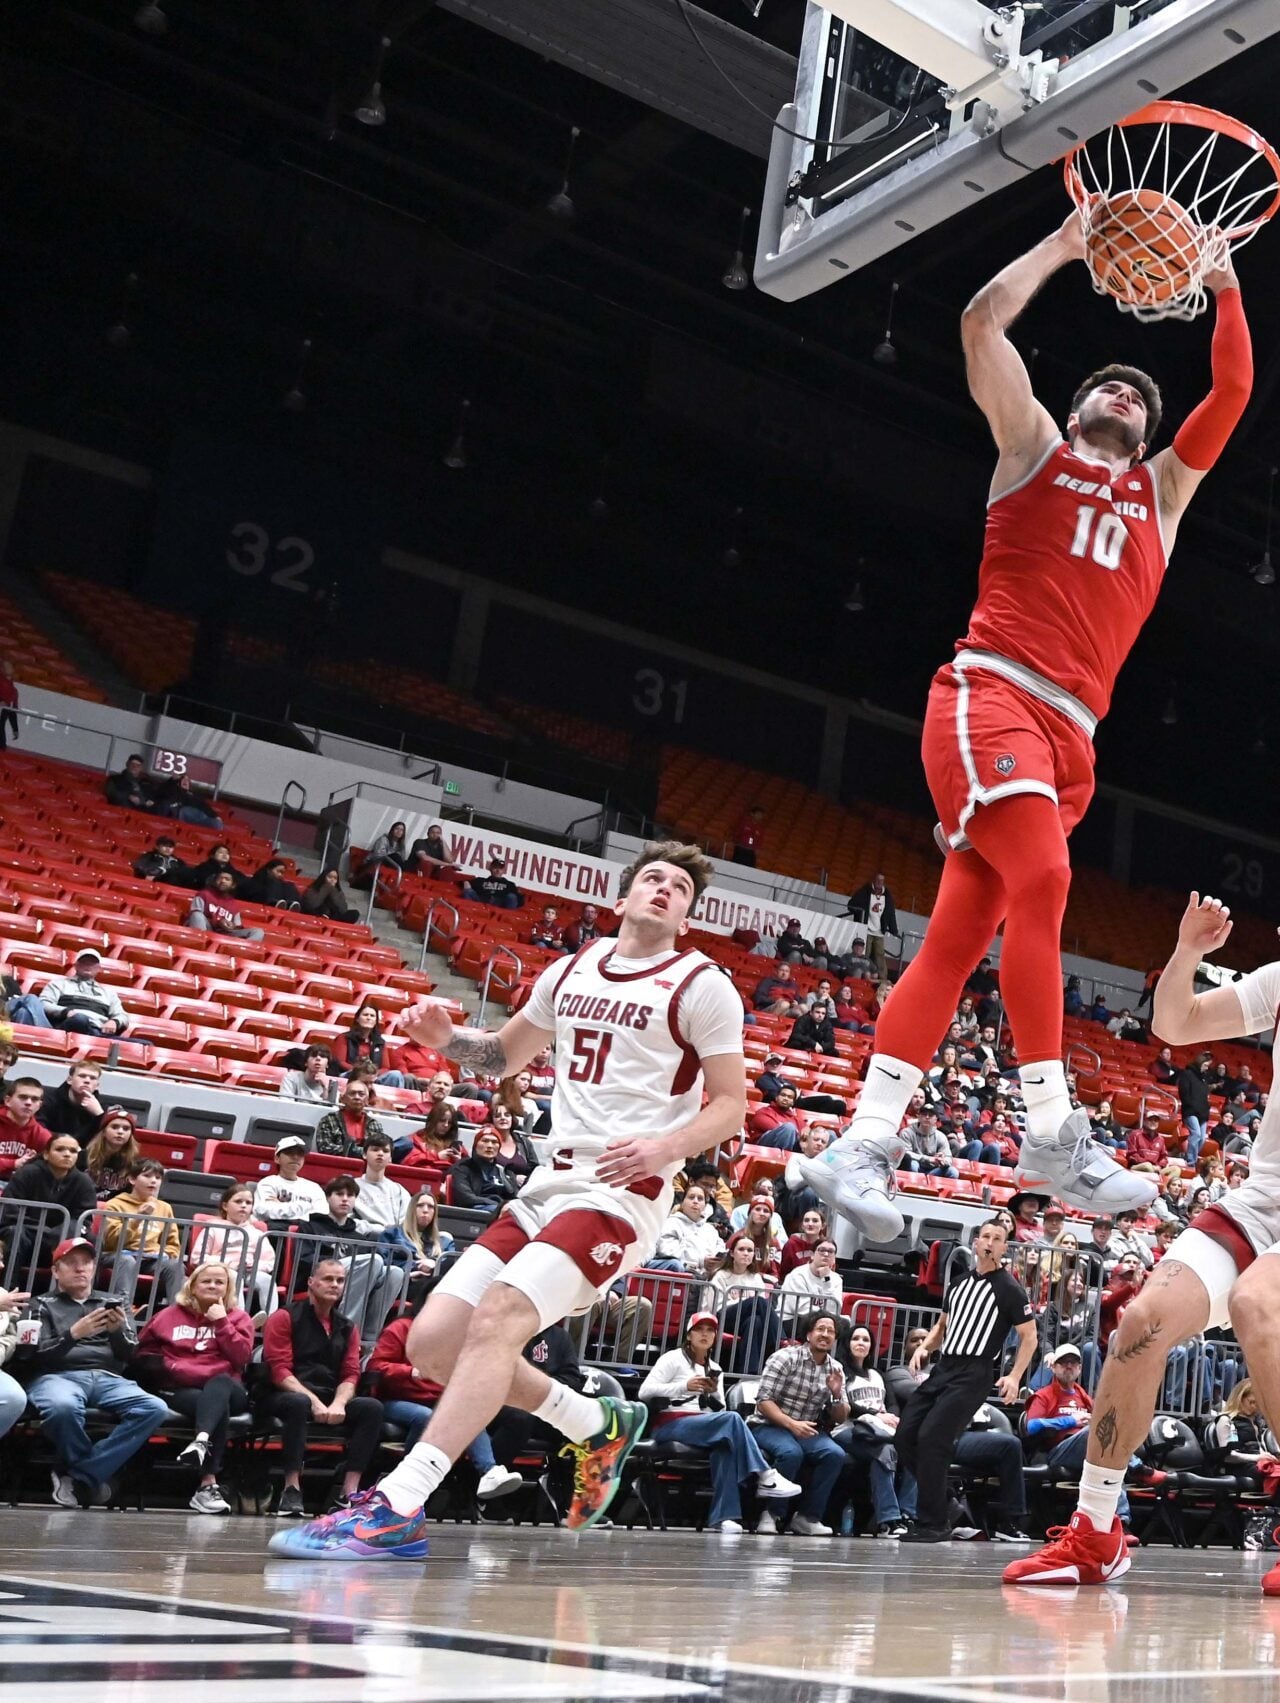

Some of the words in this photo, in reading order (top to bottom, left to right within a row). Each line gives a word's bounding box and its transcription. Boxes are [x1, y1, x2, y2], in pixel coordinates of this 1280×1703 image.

[225, 522, 316, 593] 32
[1069, 503, 1129, 571] 10
[632, 668, 688, 724] 31
[161, 751, 187, 775] 33
[450, 832, 611, 899] WASHINGTON
[1221, 854, 1264, 897] 29
[208, 903, 233, 922] WSU
[557, 993, 654, 1031] COUGARS
[567, 1027, 614, 1085] 51
